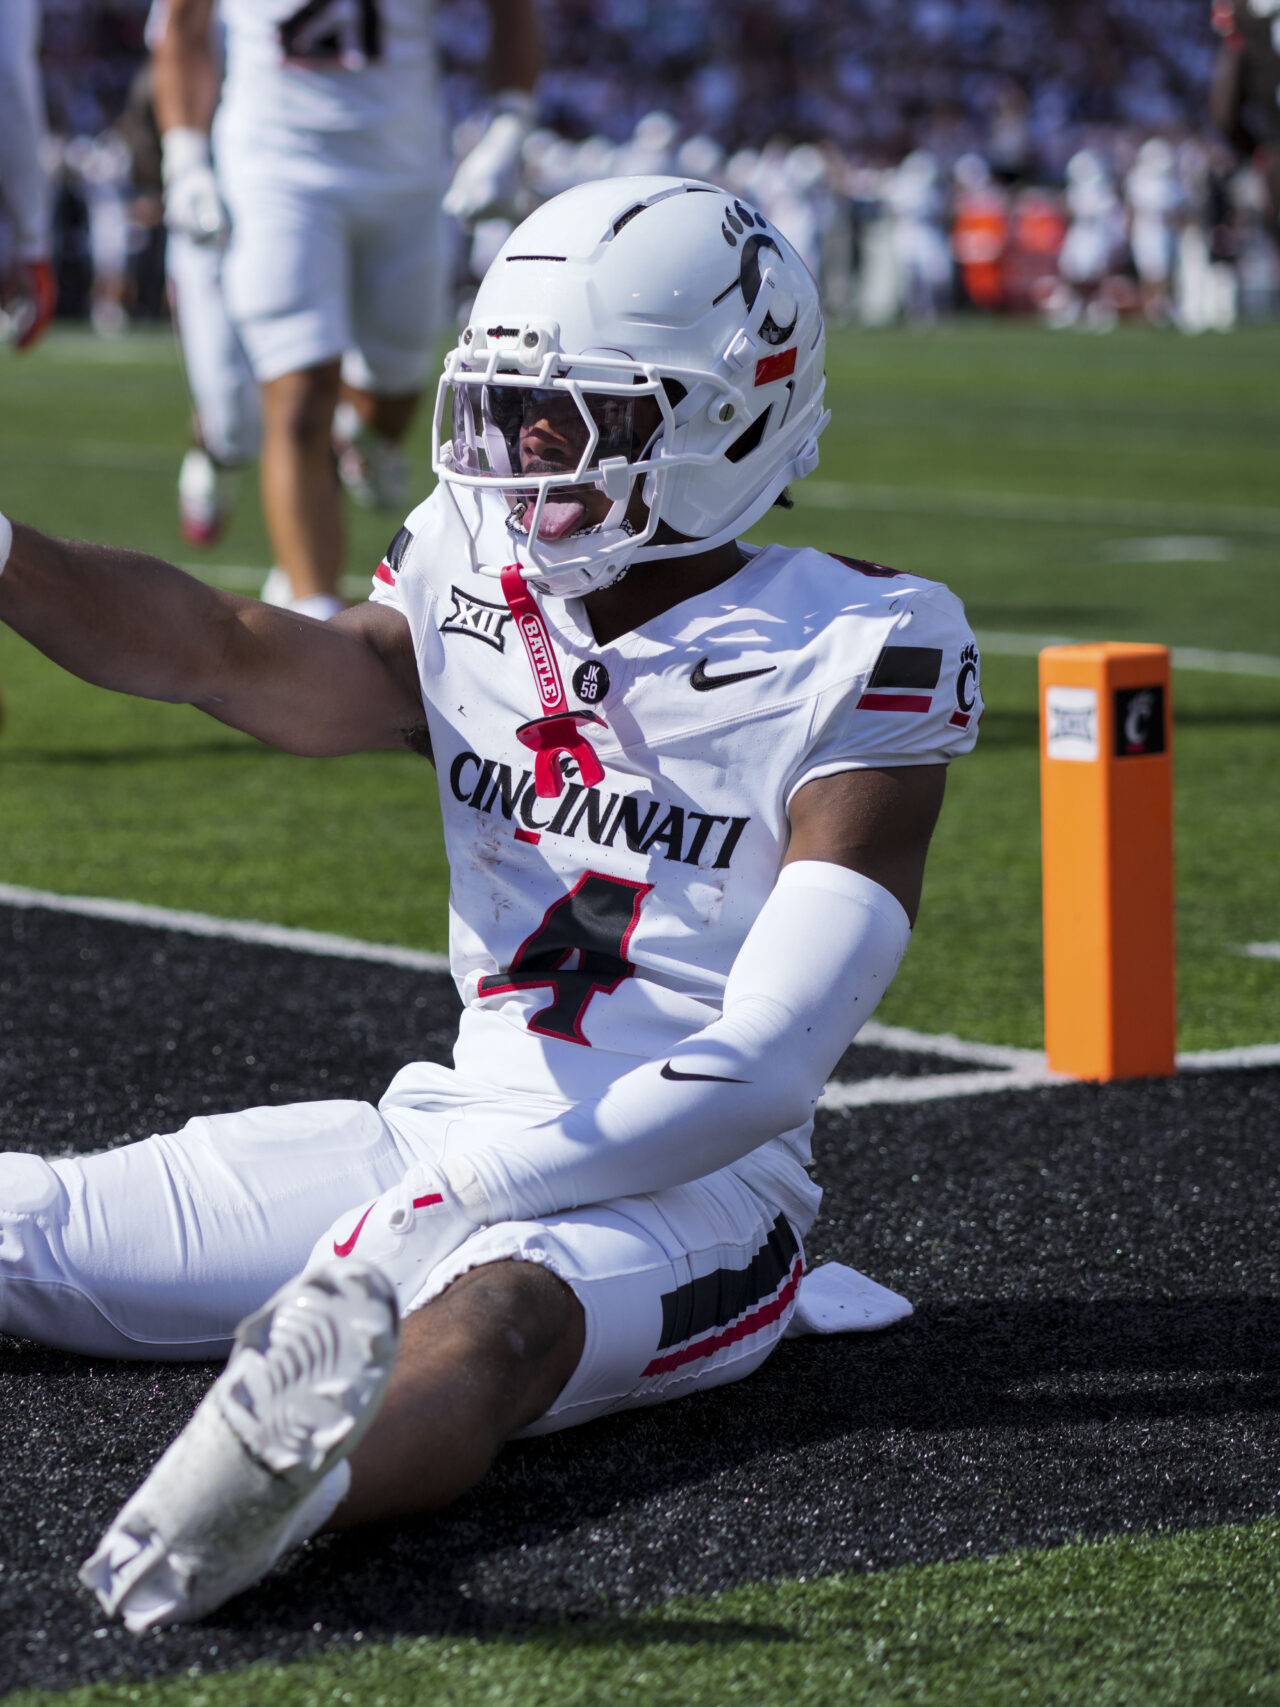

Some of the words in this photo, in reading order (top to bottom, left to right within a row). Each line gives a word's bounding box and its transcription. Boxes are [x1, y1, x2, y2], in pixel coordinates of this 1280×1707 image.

[523, 619, 557, 700] BATTLE
[580, 682, 598, 700] 58
[583, 665, 601, 683] JK
[450, 751, 751, 869] CINCINNATI
[477, 870, 655, 1047] 4
